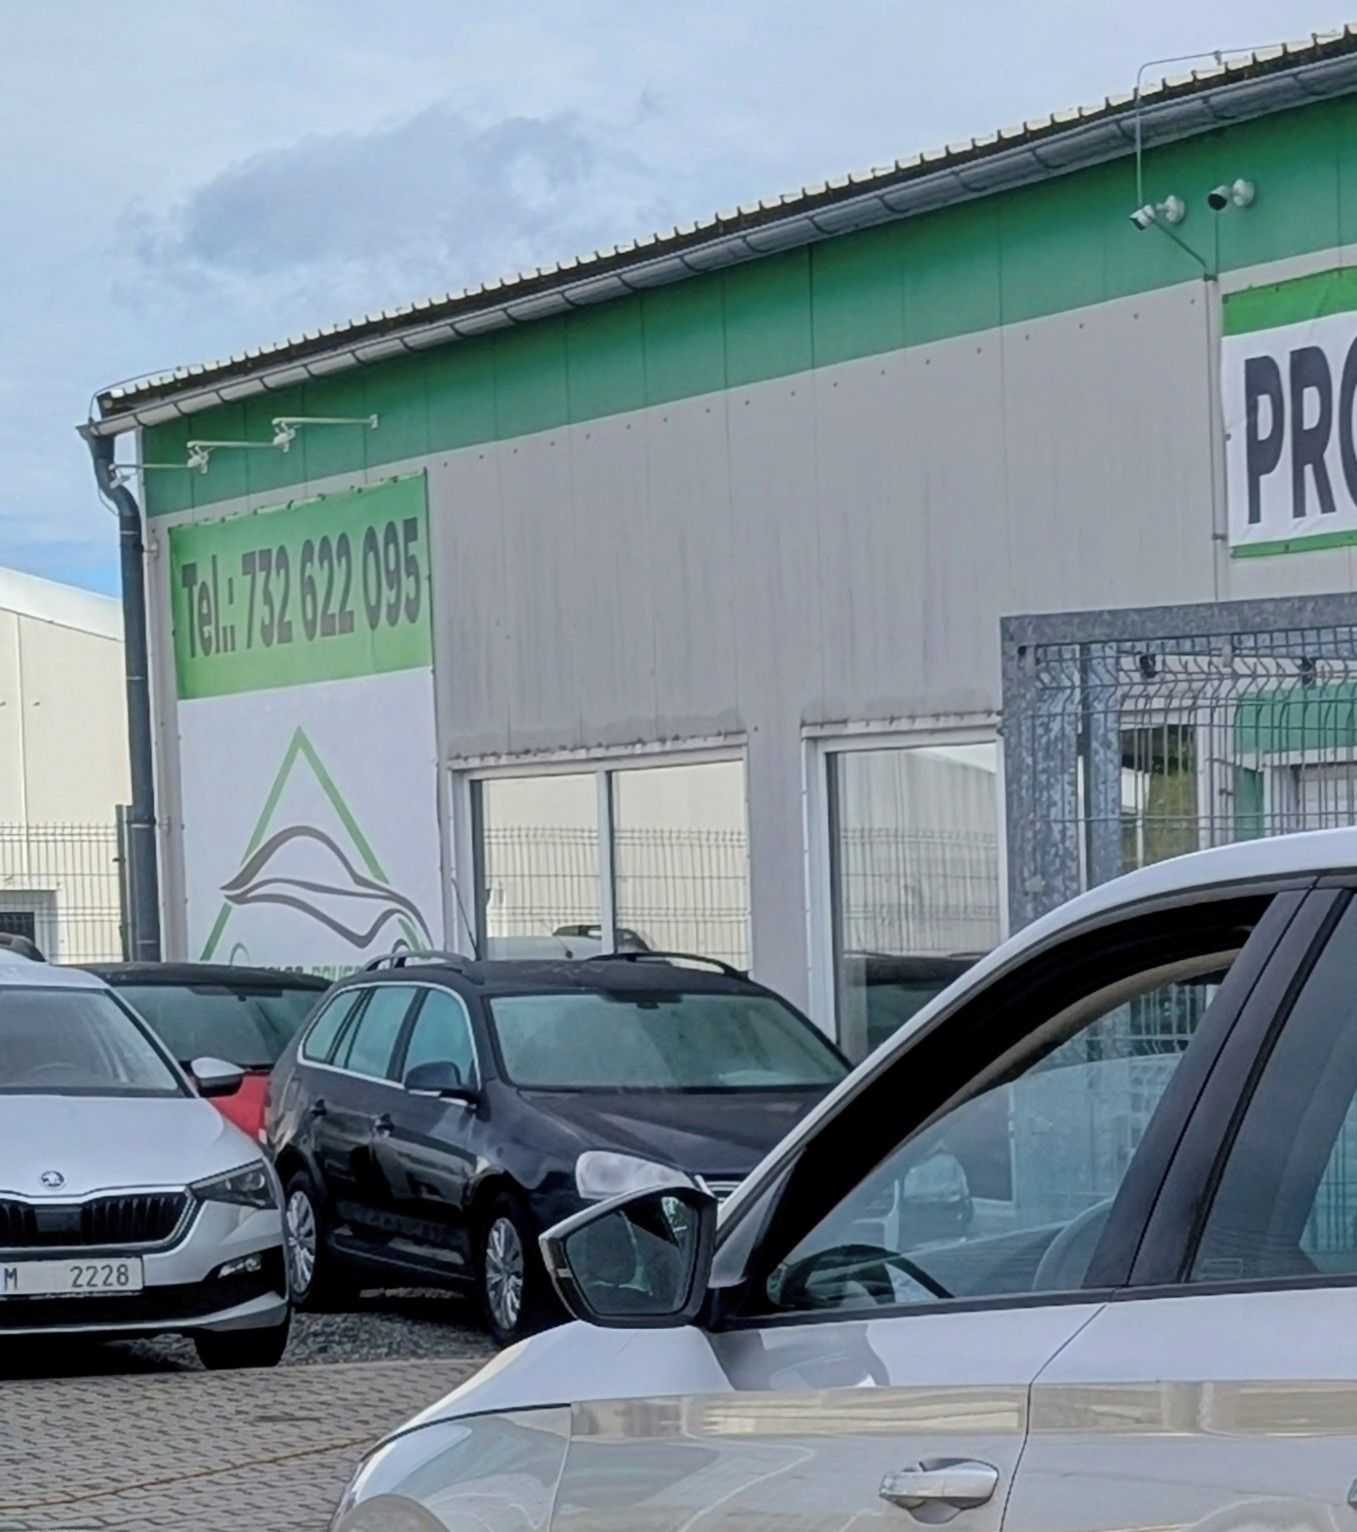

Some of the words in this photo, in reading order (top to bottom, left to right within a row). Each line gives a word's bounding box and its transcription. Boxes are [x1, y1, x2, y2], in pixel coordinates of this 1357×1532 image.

[181, 554, 236, 659] Tel.:
[242, 544, 293, 650] 732
[300, 531, 355, 642] 622
[362, 516, 422, 631] 095
[70, 1263, 130, 1288] 2228
